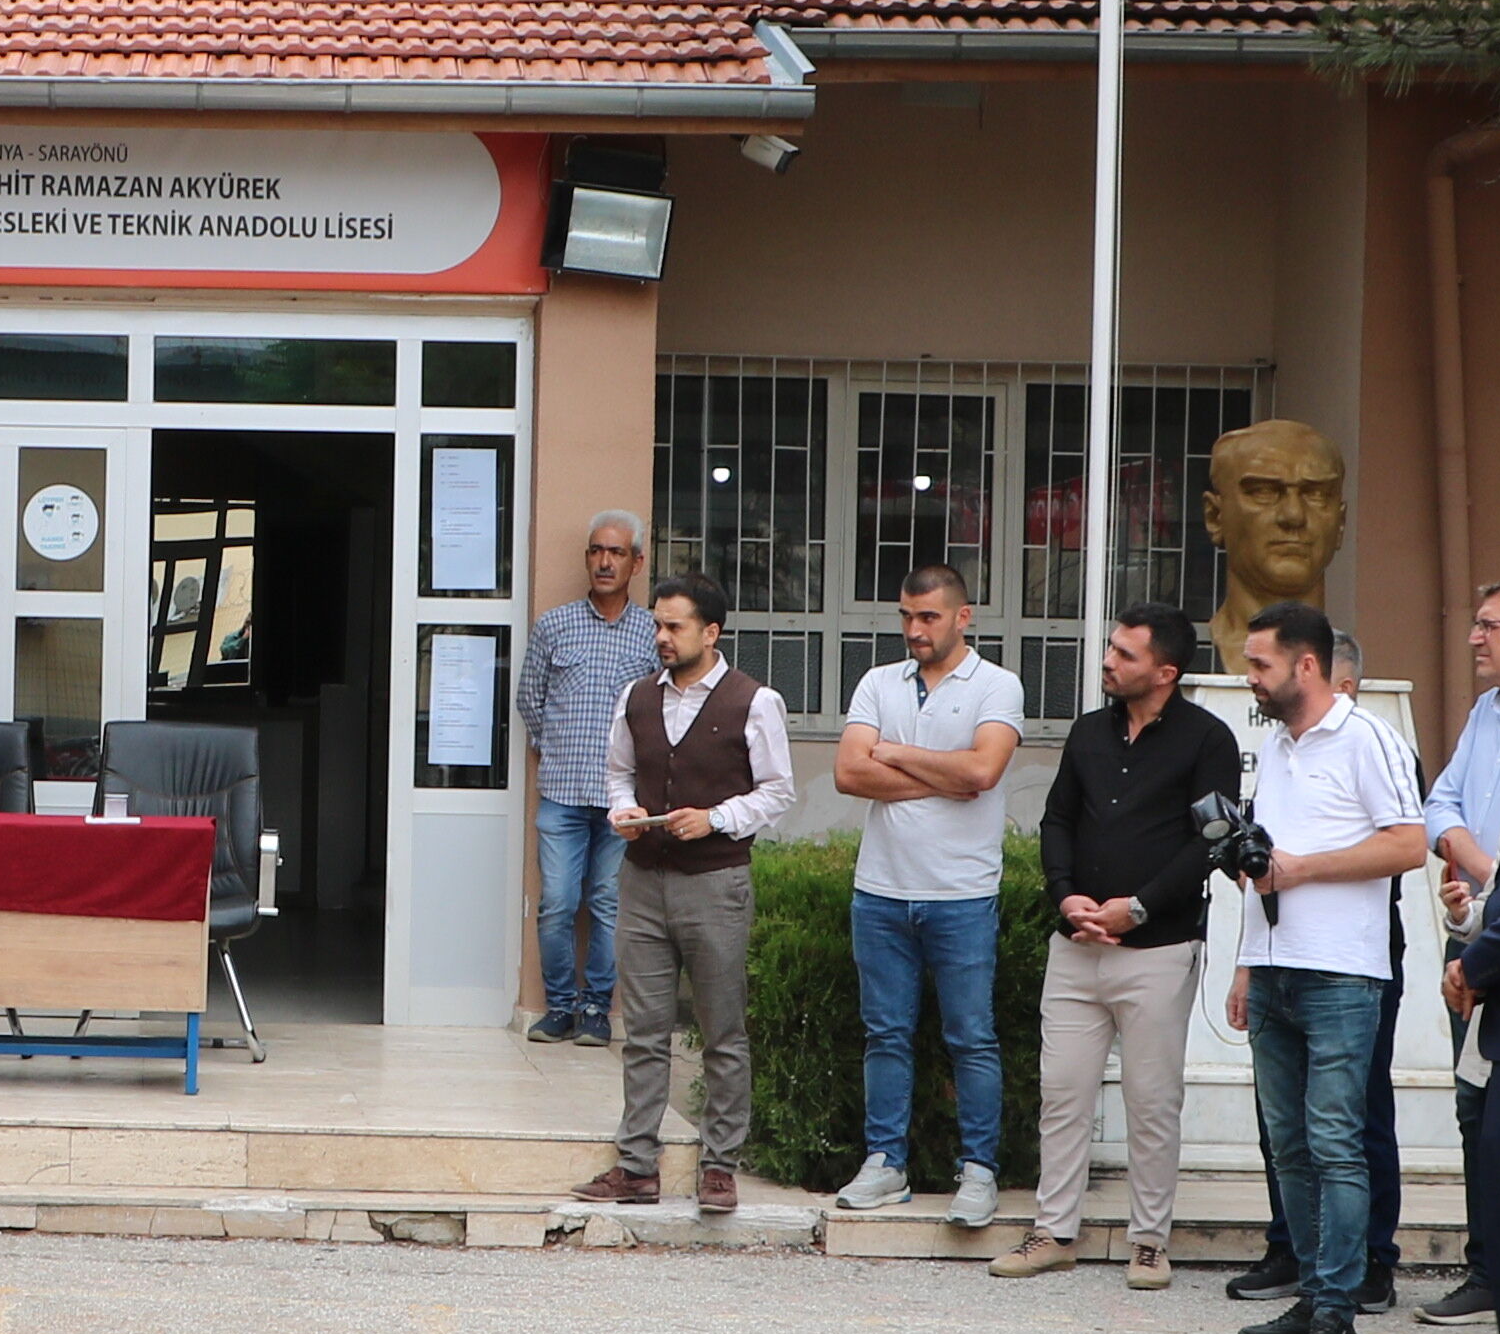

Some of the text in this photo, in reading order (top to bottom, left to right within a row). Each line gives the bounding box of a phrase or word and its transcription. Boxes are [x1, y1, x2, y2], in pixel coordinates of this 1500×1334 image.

[38, 143, 129, 163] SARAYÖNÜ
[41, 175, 163, 199] RAMAZAN
[169, 172, 282, 200] AKYÜREK
[73, 213, 102, 235] VE
[107, 209, 193, 237] TEKNİK
[199, 215, 318, 240] ANADOLU
[324, 212, 393, 240] LİSESİ
